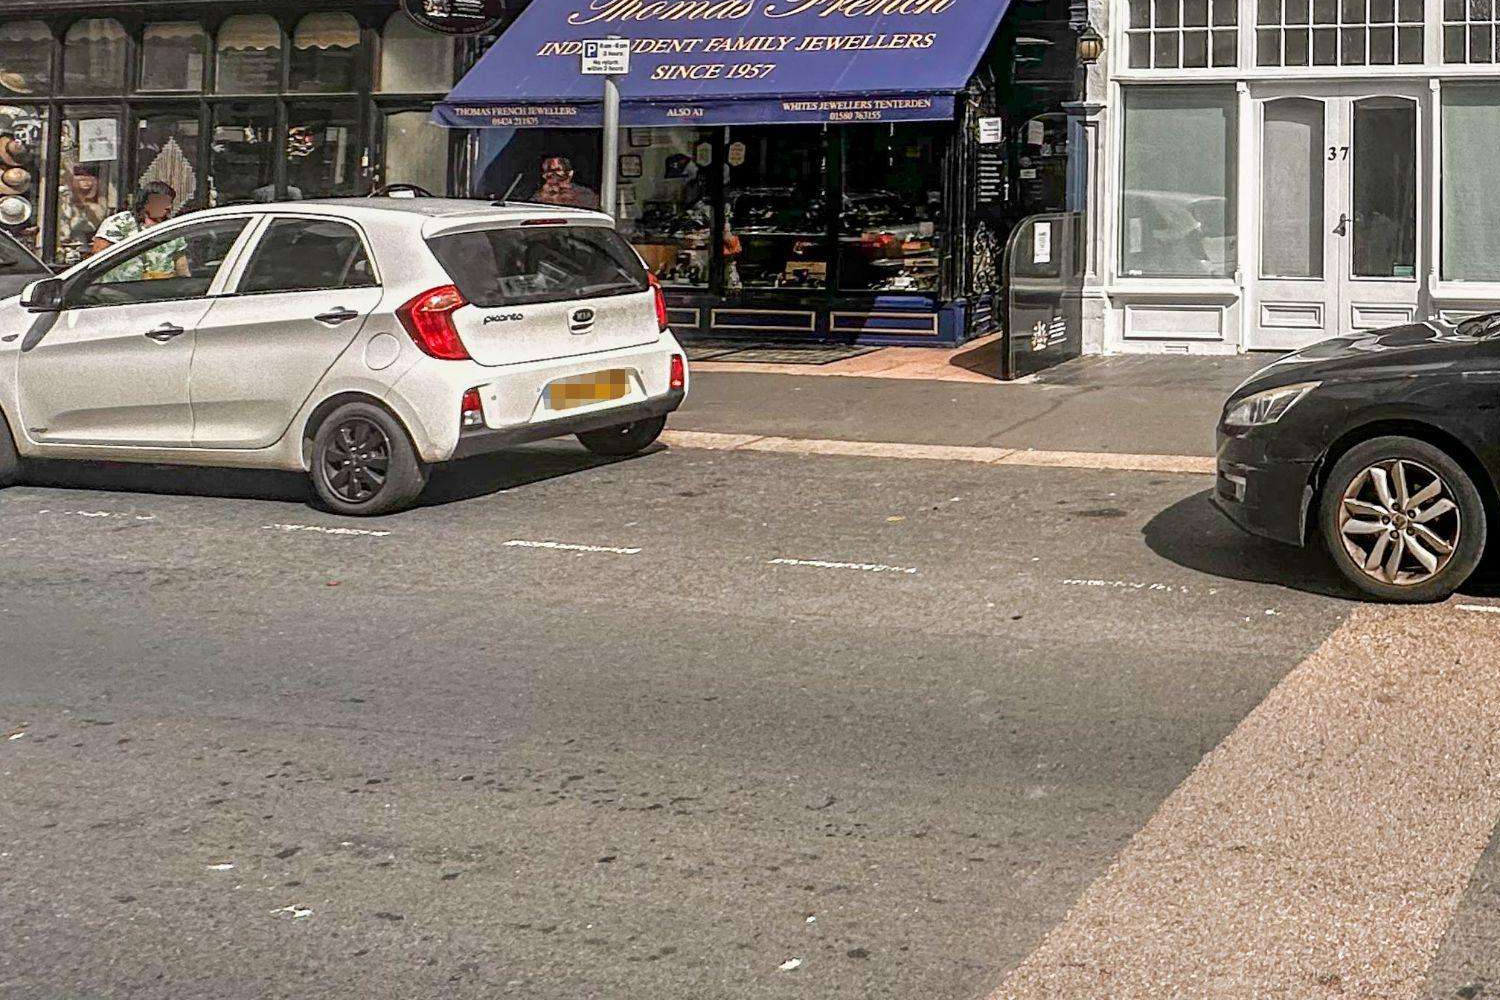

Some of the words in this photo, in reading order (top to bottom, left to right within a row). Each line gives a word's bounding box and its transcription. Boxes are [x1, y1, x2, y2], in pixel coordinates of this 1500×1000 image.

[536, 38, 703, 56] INDDENT
[702, 36, 795, 52] FAMILY
[795, 33, 937, 51] JEWELLERS
[651, 64, 725, 80] SINCE
[724, 63, 777, 80] 1957
[454, 107, 492, 116] THOMAS
[492, 107, 526, 116] FRENCH
[527, 106, 577, 115] JEWELLERS
[782, 101, 817, 111] WHITES
[818, 100, 873, 110] JEWELLERS
[874, 98, 932, 109] TENTERDEN
[666, 108, 690, 117] ALSO
[1327, 146, 1349, 161] 37
[483, 312, 524, 325] picanto
